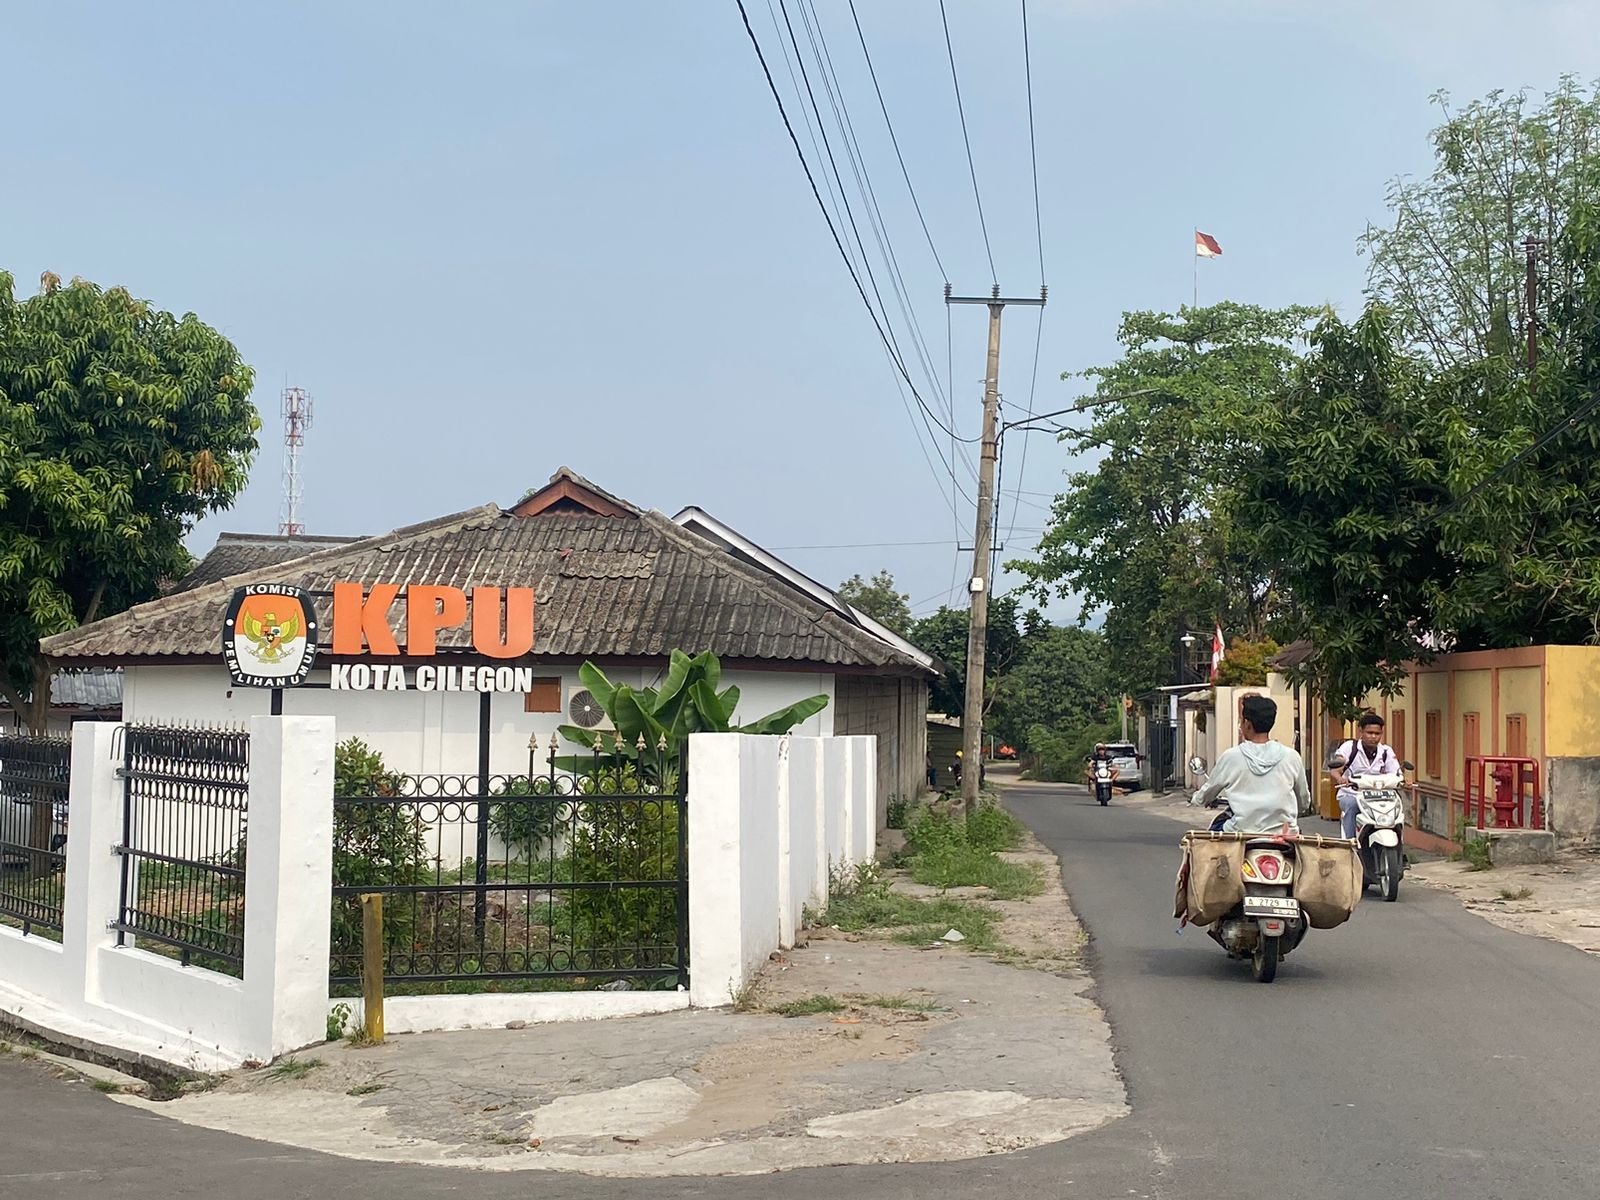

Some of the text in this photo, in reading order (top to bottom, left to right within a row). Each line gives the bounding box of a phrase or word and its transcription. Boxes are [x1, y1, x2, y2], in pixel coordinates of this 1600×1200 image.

[245, 584, 301, 597] KOMISI
[333, 583, 534, 658] KPU
[225, 641, 316, 686] PEMILIHAN UMUM
[331, 663, 532, 693] KOTA CILEGON
[1259, 899, 1280, 907] 2729
